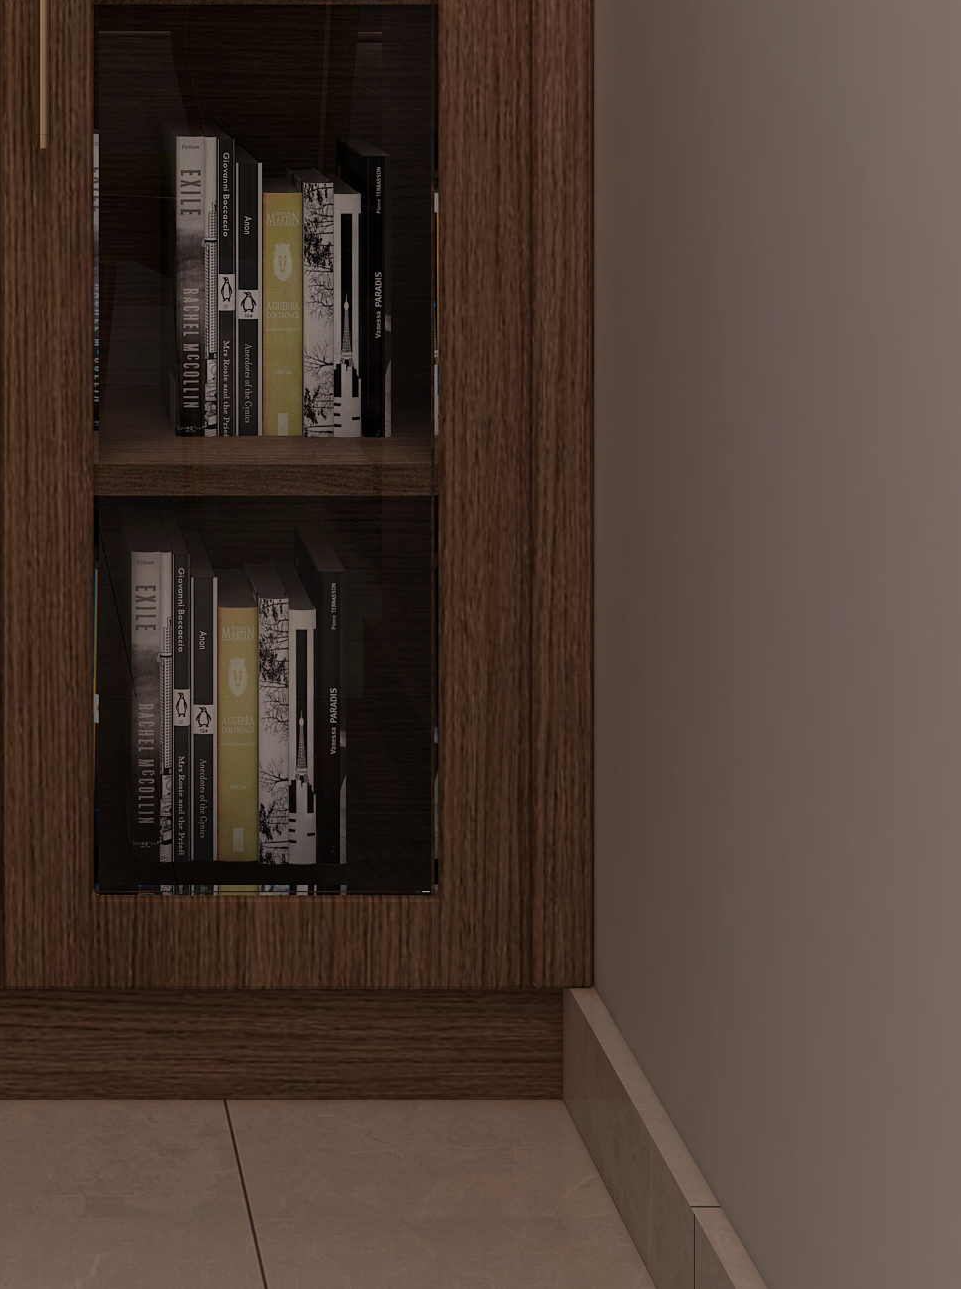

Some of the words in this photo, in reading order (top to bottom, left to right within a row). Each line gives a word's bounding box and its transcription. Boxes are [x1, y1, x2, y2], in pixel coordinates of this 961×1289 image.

[222, 152, 230, 192] Giovanni
[180, 170, 200, 216] EXILE
[222, 194, 230, 237] Boccaccio
[243, 216, 252, 235] Anon
[374, 272, 383, 308] PARADIS
[182, 288, 199, 337] RACHEL
[374, 311, 382, 338] Vanessa
[244, 344, 252, 375] Anecdotes
[244, 388, 252, 399] the
[242, 400, 252, 424] Cynics
[135, 585, 157, 631] EXILE
[177, 609, 185, 653] Boccaccio
[199, 630, 207, 650] Anon
[330, 687, 338, 724] PARADIS
[138, 703, 154, 752] RACHEL
[199, 758, 207, 789] Anecdotes
[199, 791, 207, 802] of
[199, 802, 207, 815] the
[198, 816, 207, 839] Cynics
